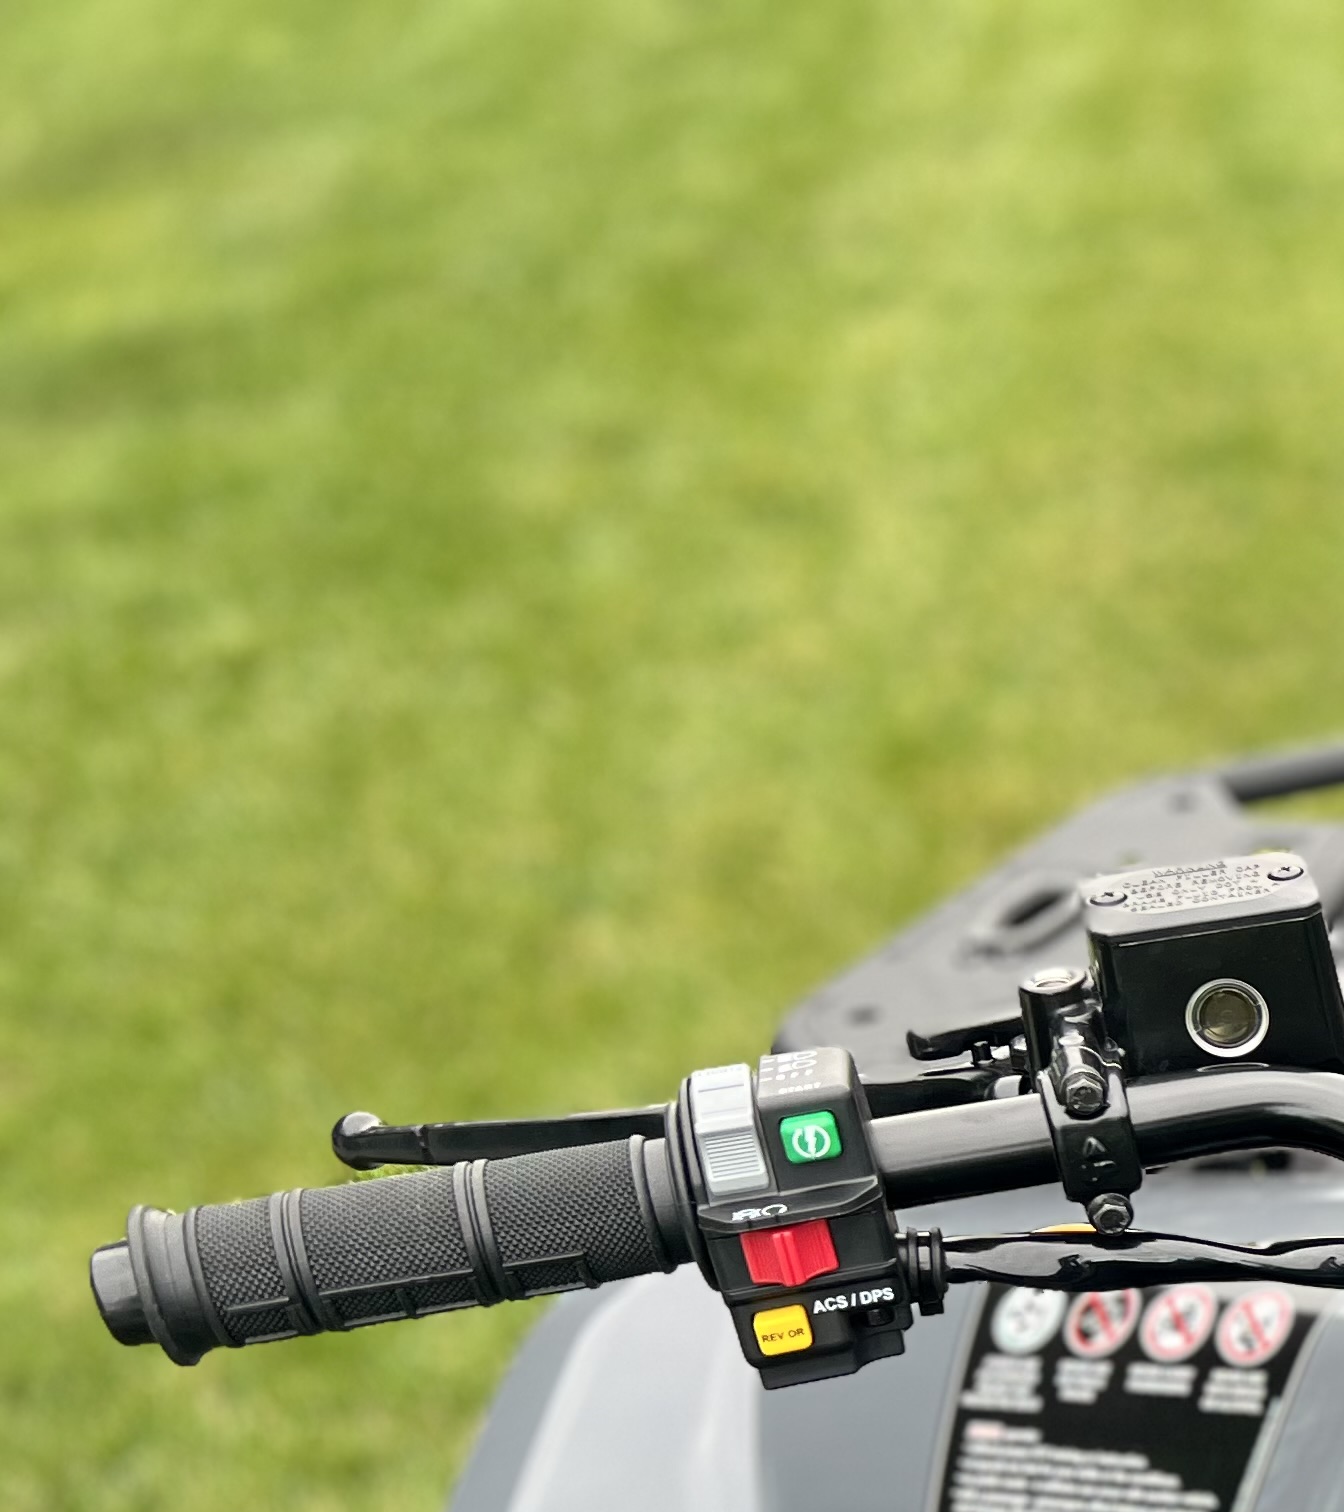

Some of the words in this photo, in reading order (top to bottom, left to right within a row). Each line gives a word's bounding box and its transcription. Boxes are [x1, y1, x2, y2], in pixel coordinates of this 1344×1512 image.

[813, 1295, 847, 1314] ACS
[860, 1287, 895, 1305] DPS
[762, 1333, 785, 1342] REV
